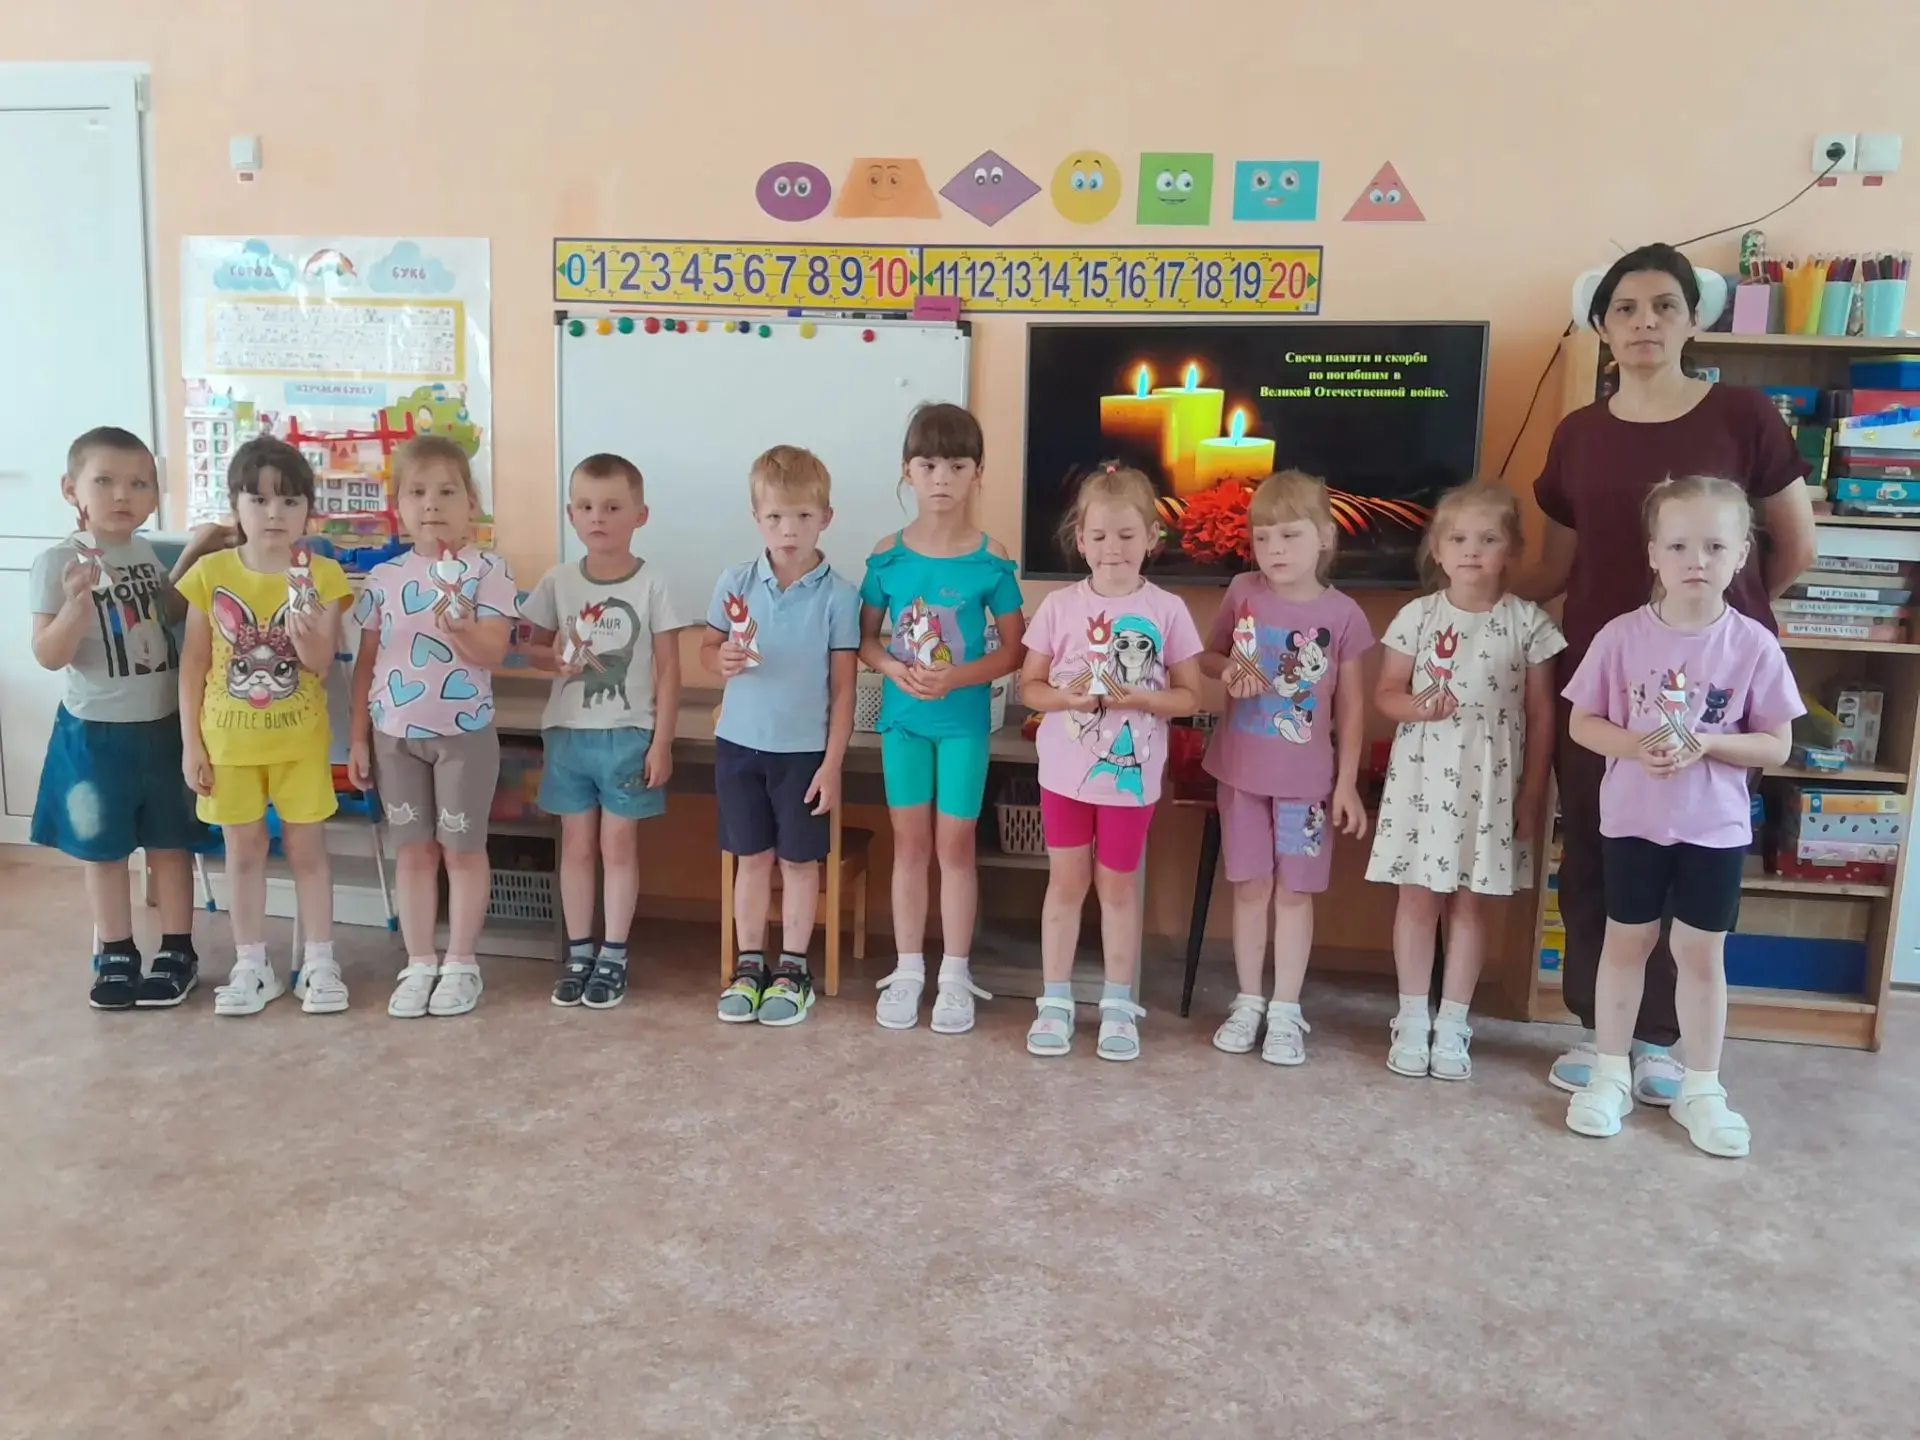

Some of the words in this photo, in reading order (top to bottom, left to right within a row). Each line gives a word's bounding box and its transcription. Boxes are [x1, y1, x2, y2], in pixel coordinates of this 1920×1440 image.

[565, 253, 586, 286] 0
[592, 252, 606, 289] 1
[619, 252, 641, 290] 2
[650, 252, 671, 291] 3
[680, 253, 703, 292] 4
[712, 254, 733, 293] 5
[743, 254, 765, 294] 6
[775, 255, 797, 294] 7
[808, 255, 829, 296] 8
[840, 256, 862, 296] 9
[869, 257, 908, 297] 10
[933, 261, 958, 297] 11
[964, 261, 995, 298] 12
[1003, 261, 1031, 298] 13
[1039, 261, 1070, 298] 14
[1078, 261, 1108, 298] 15
[1116, 261, 1146, 298] 16
[1153, 261, 1185, 299] 17
[1191, 261, 1222, 299] 18
[1230, 261, 1261, 299] 19
[1268, 262, 1306, 299] 20
[1285, 352, 1322, 363] Свеча
[1325, 353, 1371, 363] памяти
[1374, 353, 1382, 363] и
[1385, 352, 1428, 365] скорби
[1308, 371, 1323, 380] по
[1326, 369, 1389, 380] погибшим
[1393, 371, 1401, 380] в
[1260, 386, 1311, 398] Великой
[1314, 386, 1405, 398] Отечественной
[1410, 386, 1449, 398] войне.
[216, 711, 257, 729] LITTLE
